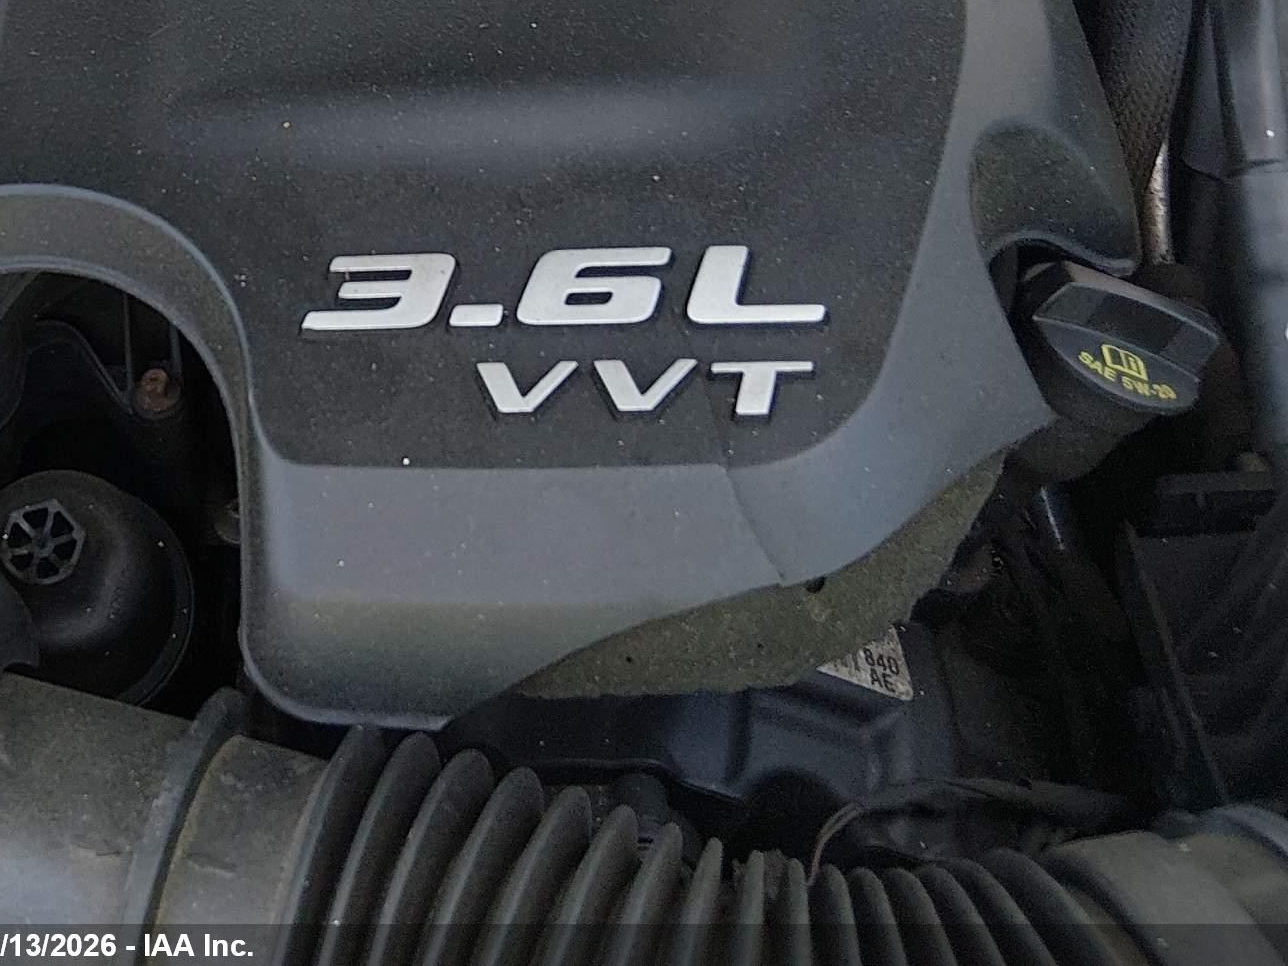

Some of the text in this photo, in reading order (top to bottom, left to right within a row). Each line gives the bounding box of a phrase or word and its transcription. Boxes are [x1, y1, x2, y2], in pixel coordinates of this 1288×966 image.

[301, 245, 826, 331] 3.6L
[475, 358, 814, 417] VVT
[1079, 351, 1177, 399] SAE 5W-20
[865, 648, 899, 675] 840
[871, 669, 895, 692] AE
